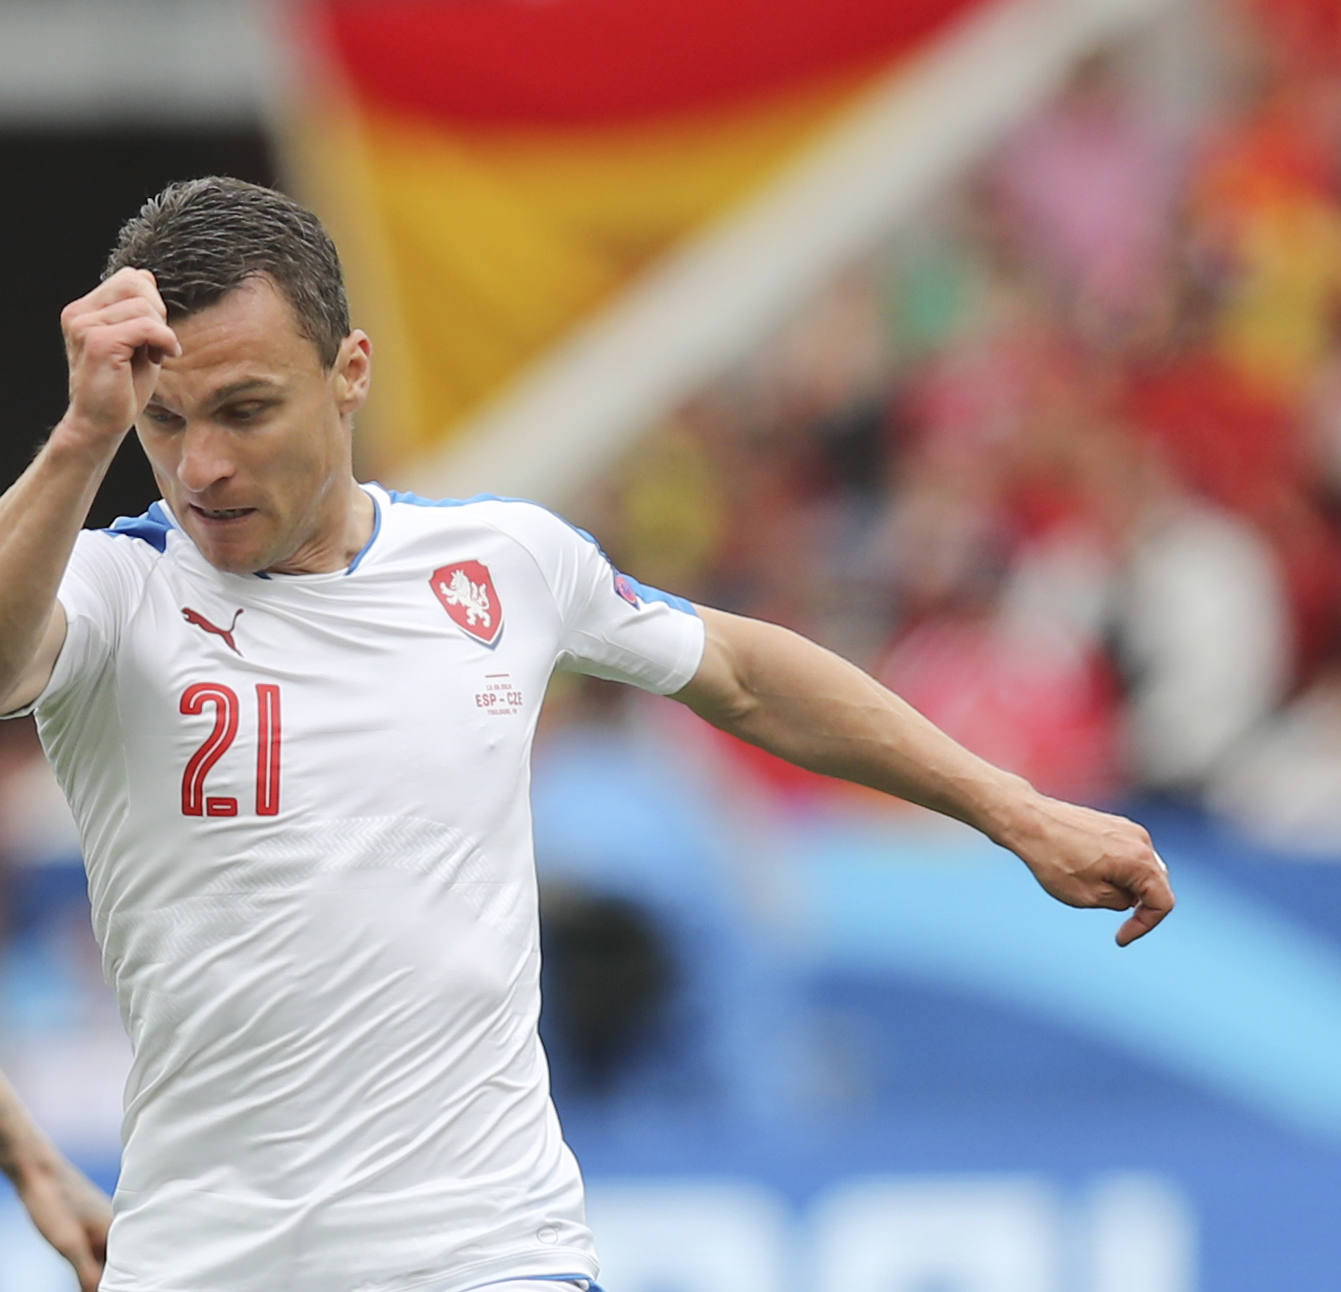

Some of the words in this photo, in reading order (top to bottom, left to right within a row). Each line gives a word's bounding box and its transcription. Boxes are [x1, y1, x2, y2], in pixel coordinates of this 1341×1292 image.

[475, 693, 497, 707] ESP
[507, 691, 523, 706] CZE
[180, 682, 281, 816] 21
